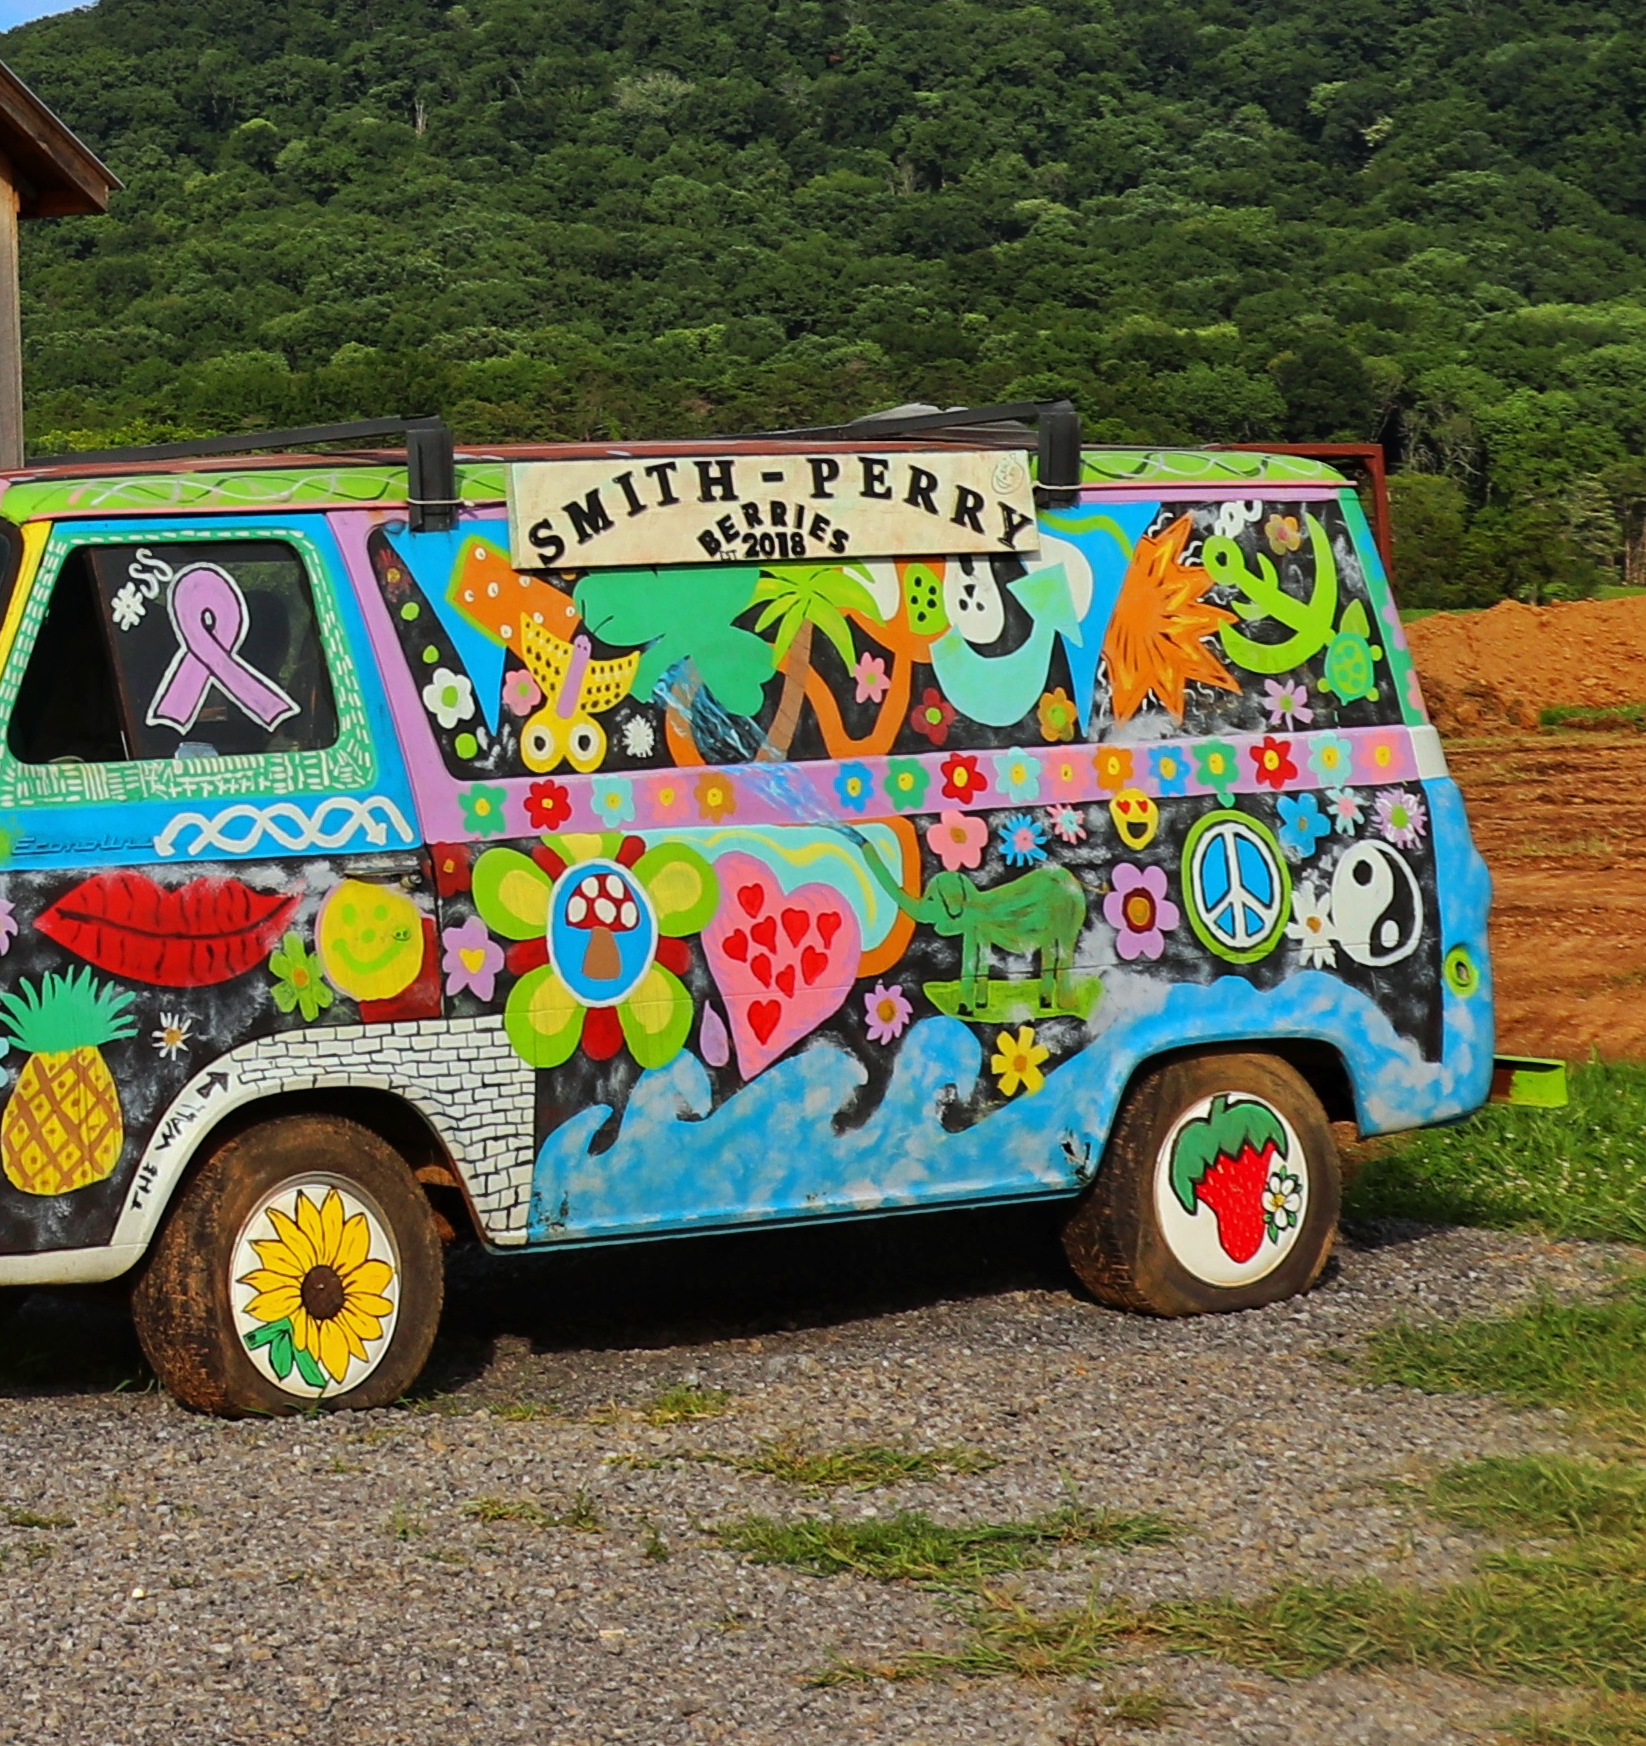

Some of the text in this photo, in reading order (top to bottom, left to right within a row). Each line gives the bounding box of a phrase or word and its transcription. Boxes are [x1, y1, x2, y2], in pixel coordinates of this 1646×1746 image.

[696, 500, 850, 557] BERRIES
[741, 531, 807, 558] 2018
[130, 1104, 206, 1210] THE WALL
